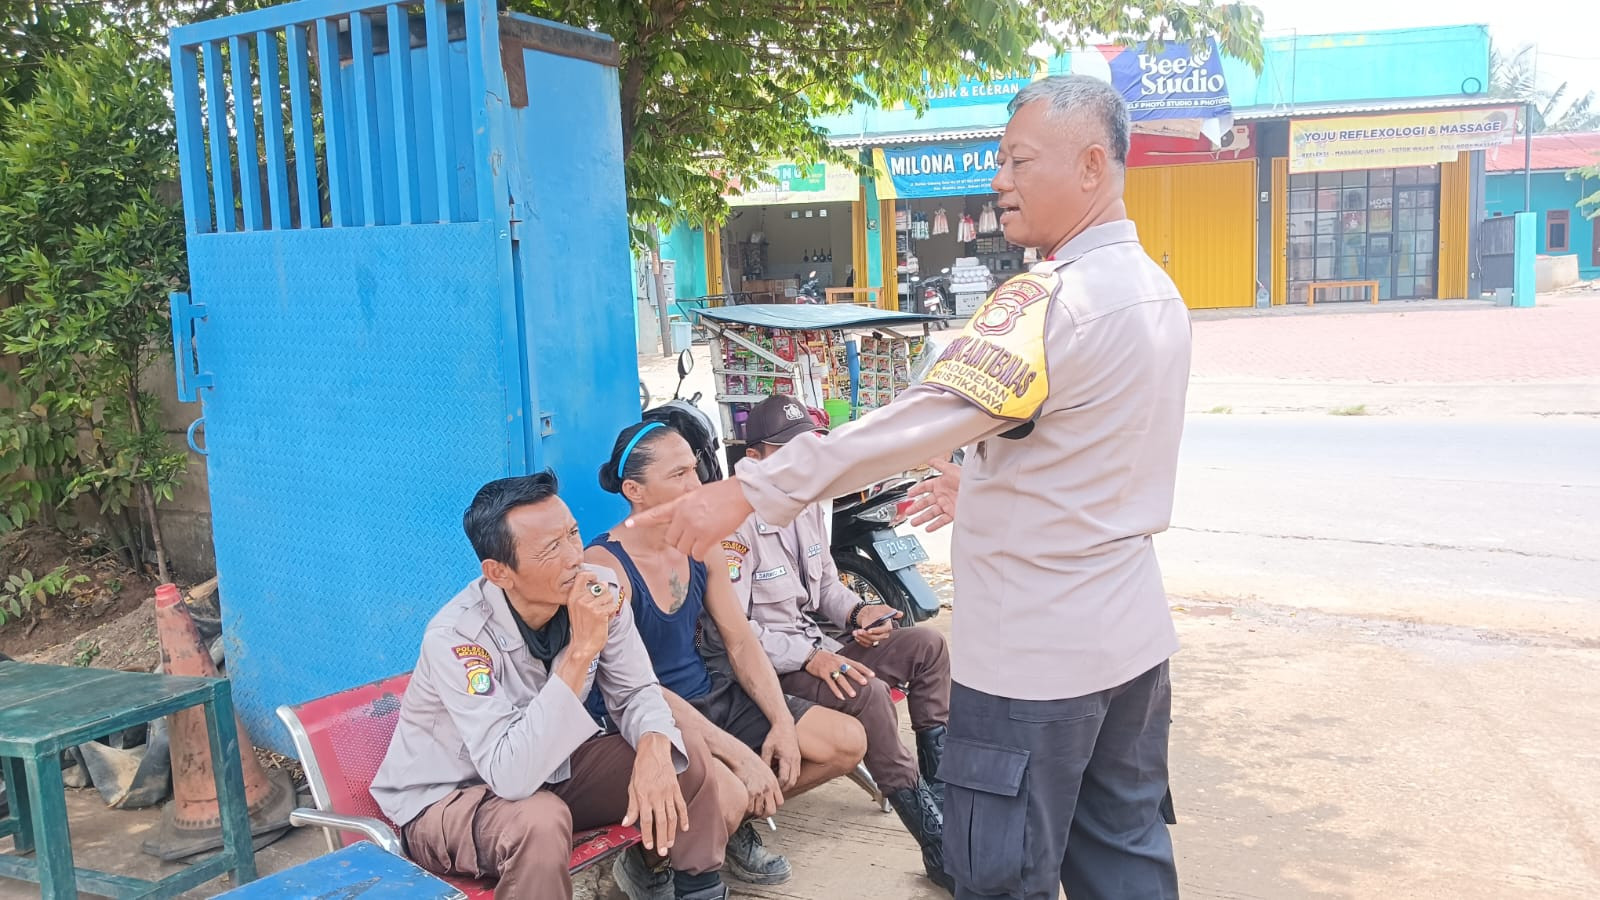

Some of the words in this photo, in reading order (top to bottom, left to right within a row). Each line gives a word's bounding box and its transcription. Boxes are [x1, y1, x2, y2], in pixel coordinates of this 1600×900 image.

[1138, 53, 1187, 75] Bee
[960, 86, 969, 97] &
[972, 83, 1019, 97] ECERAN
[1141, 69, 1225, 95] Studio
[1166, 99, 1193, 107] STUDIO
[1304, 131, 1336, 142] YOJU
[1340, 126, 1425, 140] REFLEXOLOGI
[1428, 127, 1436, 135] &
[1440, 121, 1501, 134] MASSAGE
[890, 153, 955, 176] MILONA
